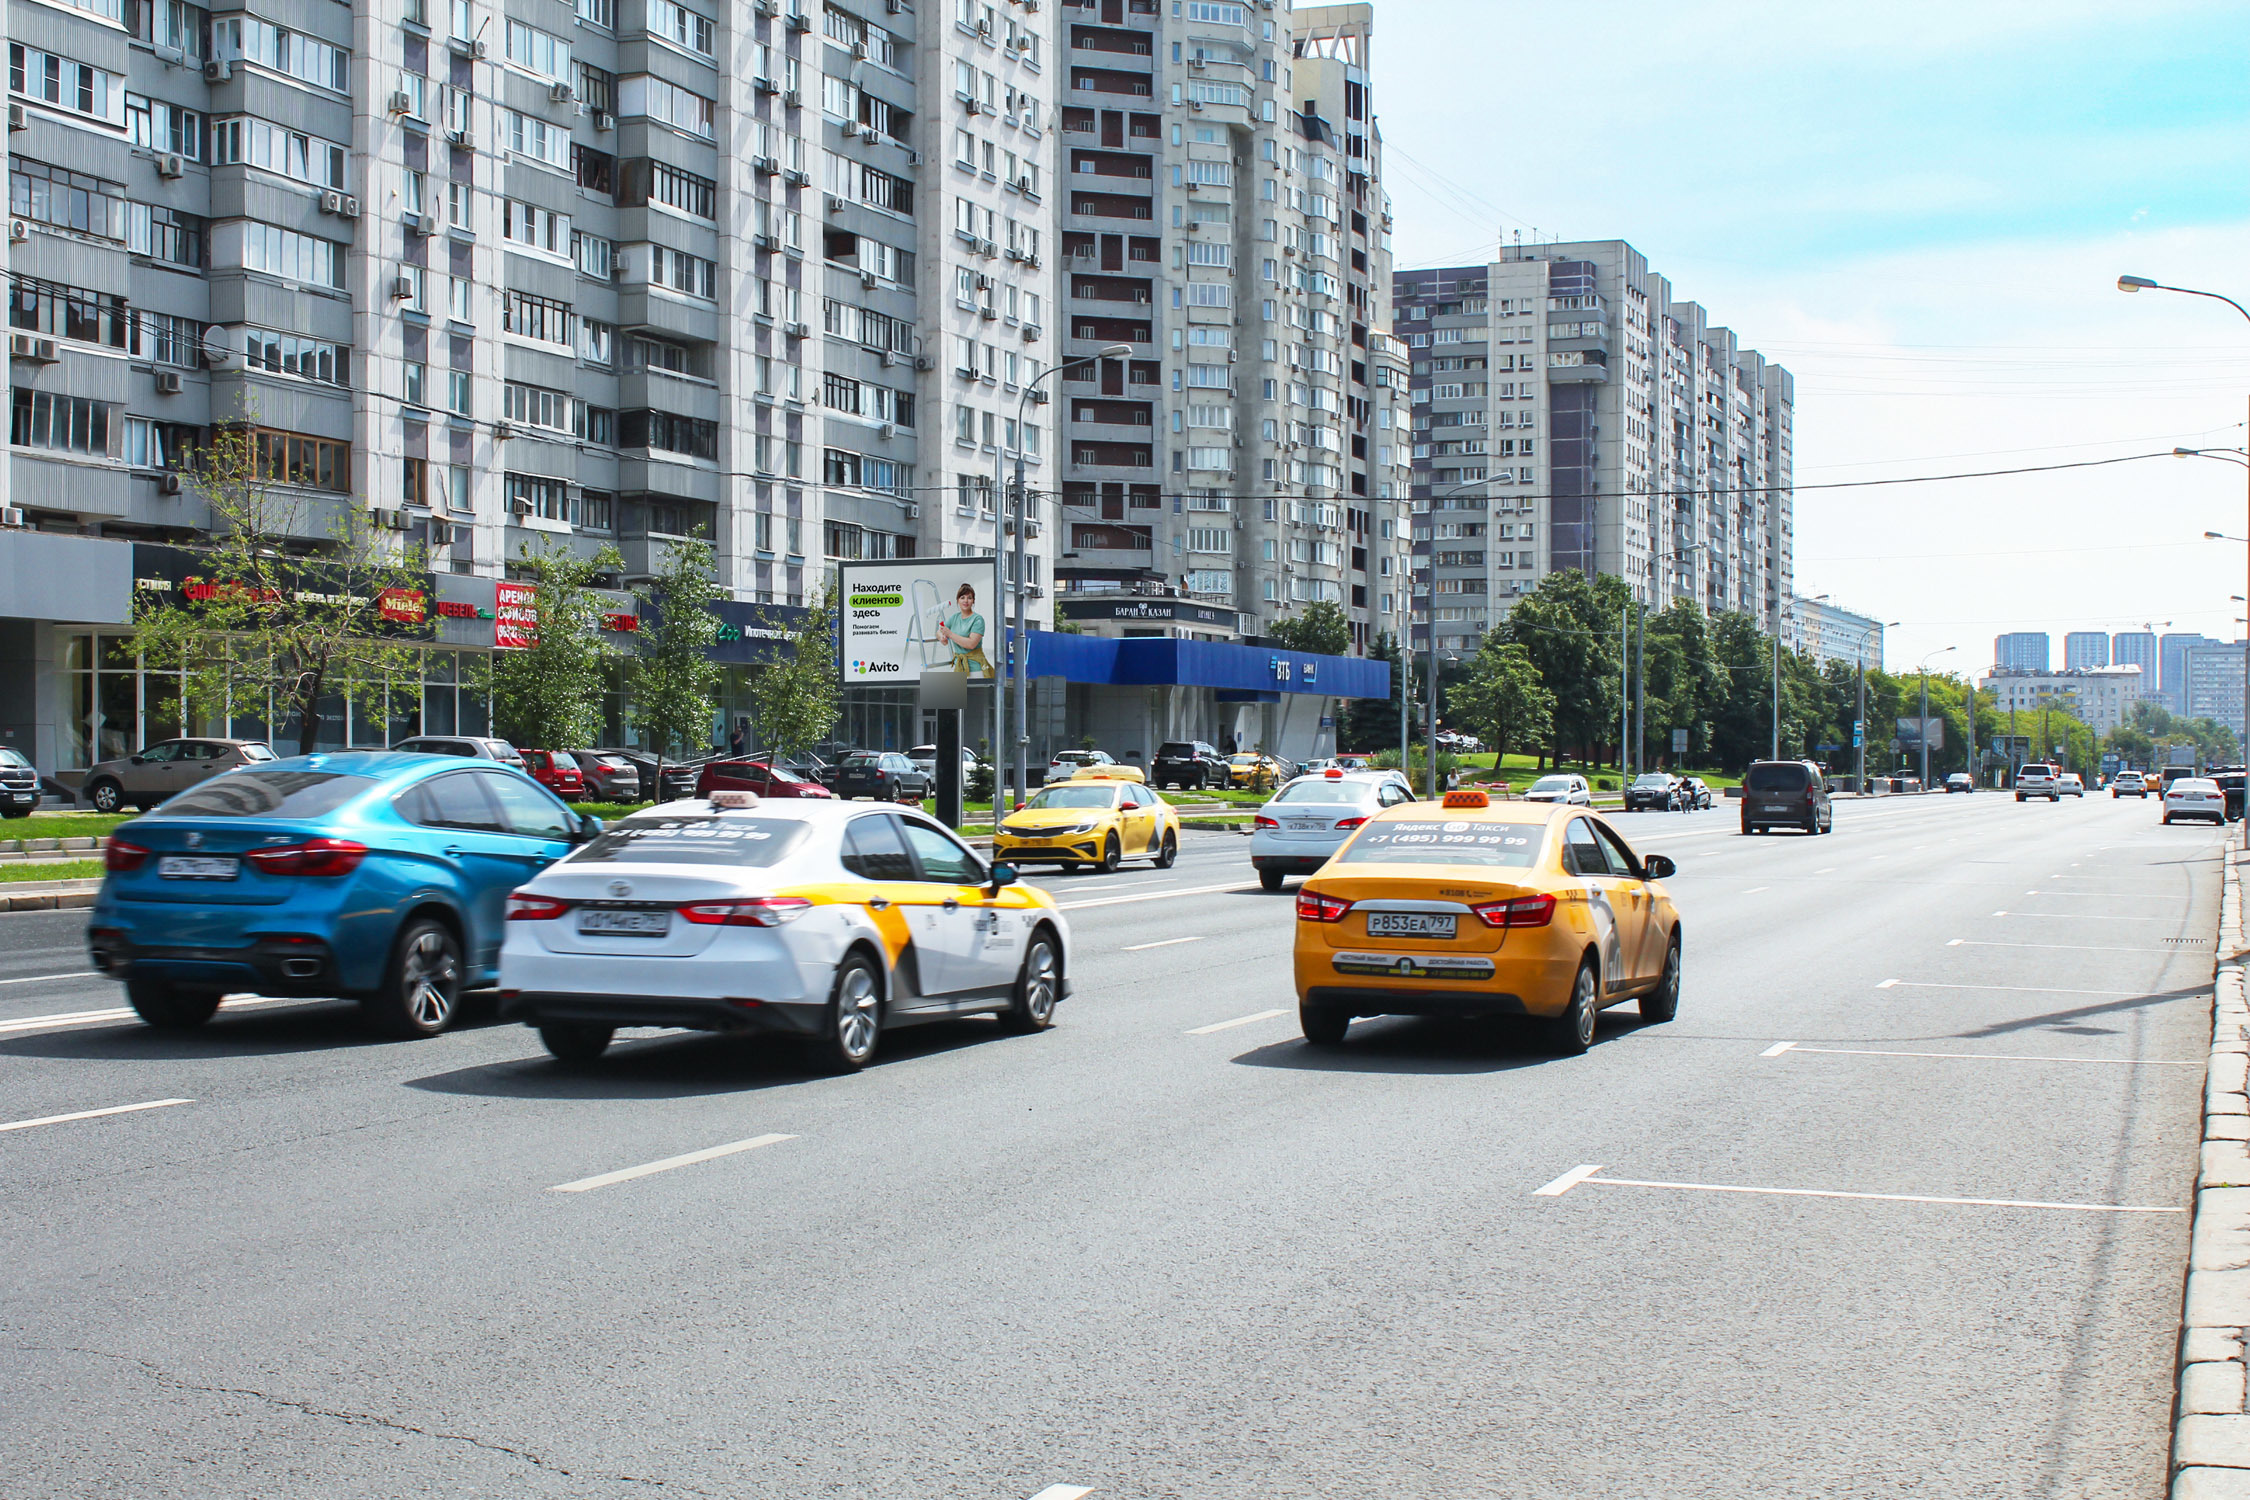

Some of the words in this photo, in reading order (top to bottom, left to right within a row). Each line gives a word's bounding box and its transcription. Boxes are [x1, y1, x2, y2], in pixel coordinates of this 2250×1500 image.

[852, 583, 902, 594] Находите
[852, 596, 901, 605] клиентов
[437, 601, 477, 618] МЕБЕЛЬ
[852, 609, 881, 619] здесь
[1115, 608, 1139, 616] БАРАН
[1148, 608, 1172, 617] КАЗАН
[869, 661, 900, 673] Avito
[1277, 660, 1290, 680] ВТБ
[1392, 823, 1441, 832] Яндекс
[1472, 823, 1510, 832] Такси
[1367, 835, 1389, 843] +7
[1391, 834, 1438, 843] (495)
[1442, 835, 1475, 843] 999
[1478, 836, 1502, 844] 99
[1504, 837, 1528, 846] 99
[1429, 916, 1452, 928] 797
